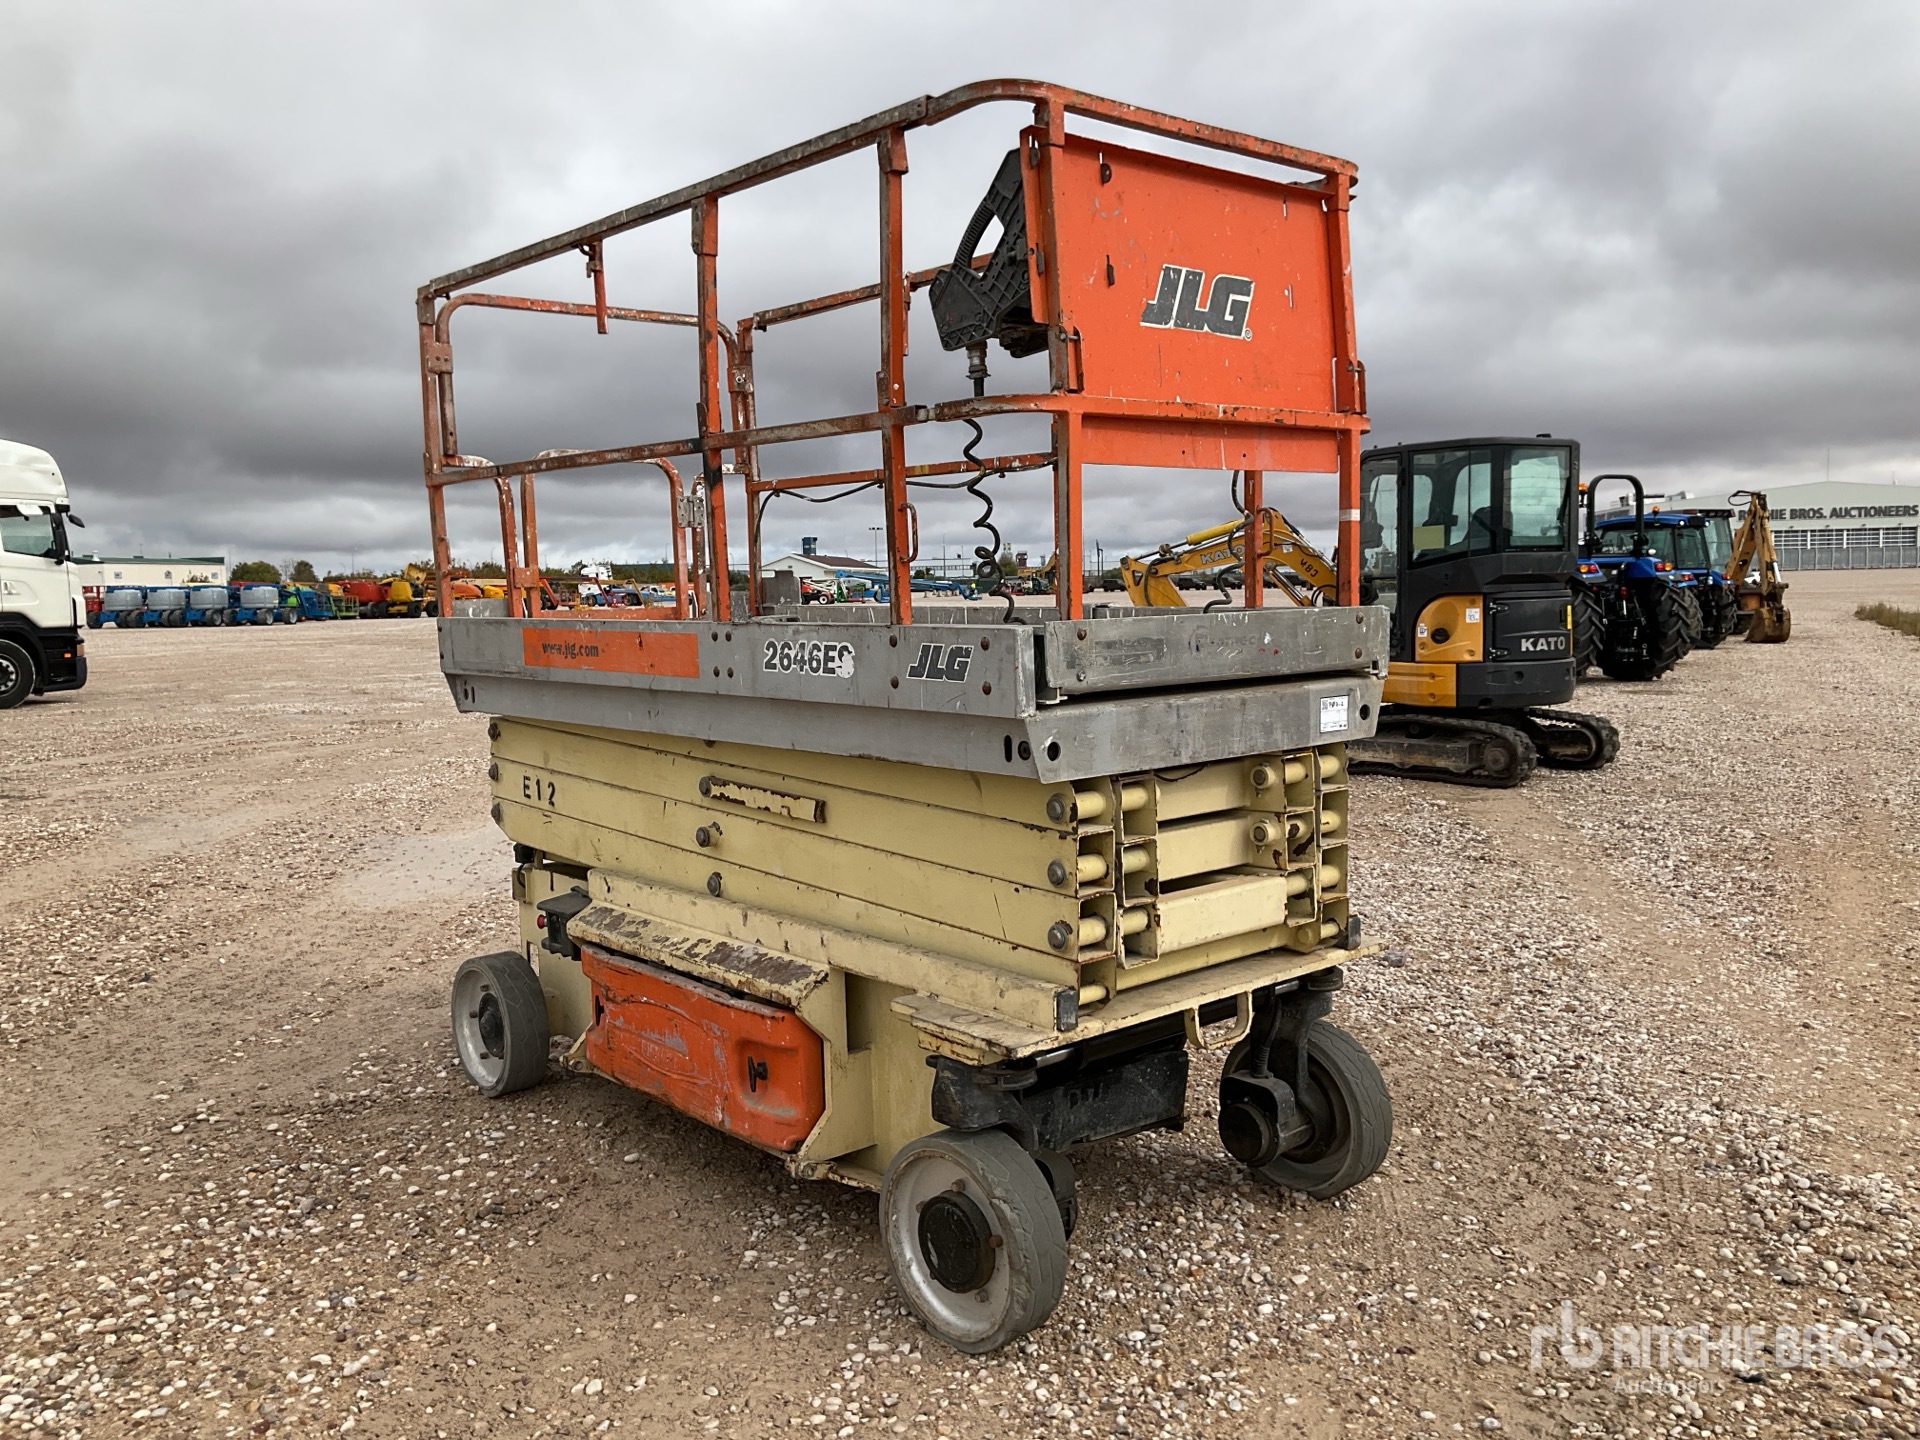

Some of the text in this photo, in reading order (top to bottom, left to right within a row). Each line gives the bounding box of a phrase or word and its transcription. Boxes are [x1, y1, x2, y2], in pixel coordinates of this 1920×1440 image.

[1140, 263, 1255, 340] JLG
[1789, 508, 1827, 520] BROS.
[1829, 505, 1919, 519] AUCTIONEERS
[1521, 636, 1566, 651] KATO
[906, 643, 974, 683] JLG
[523, 775, 556, 807] E12
